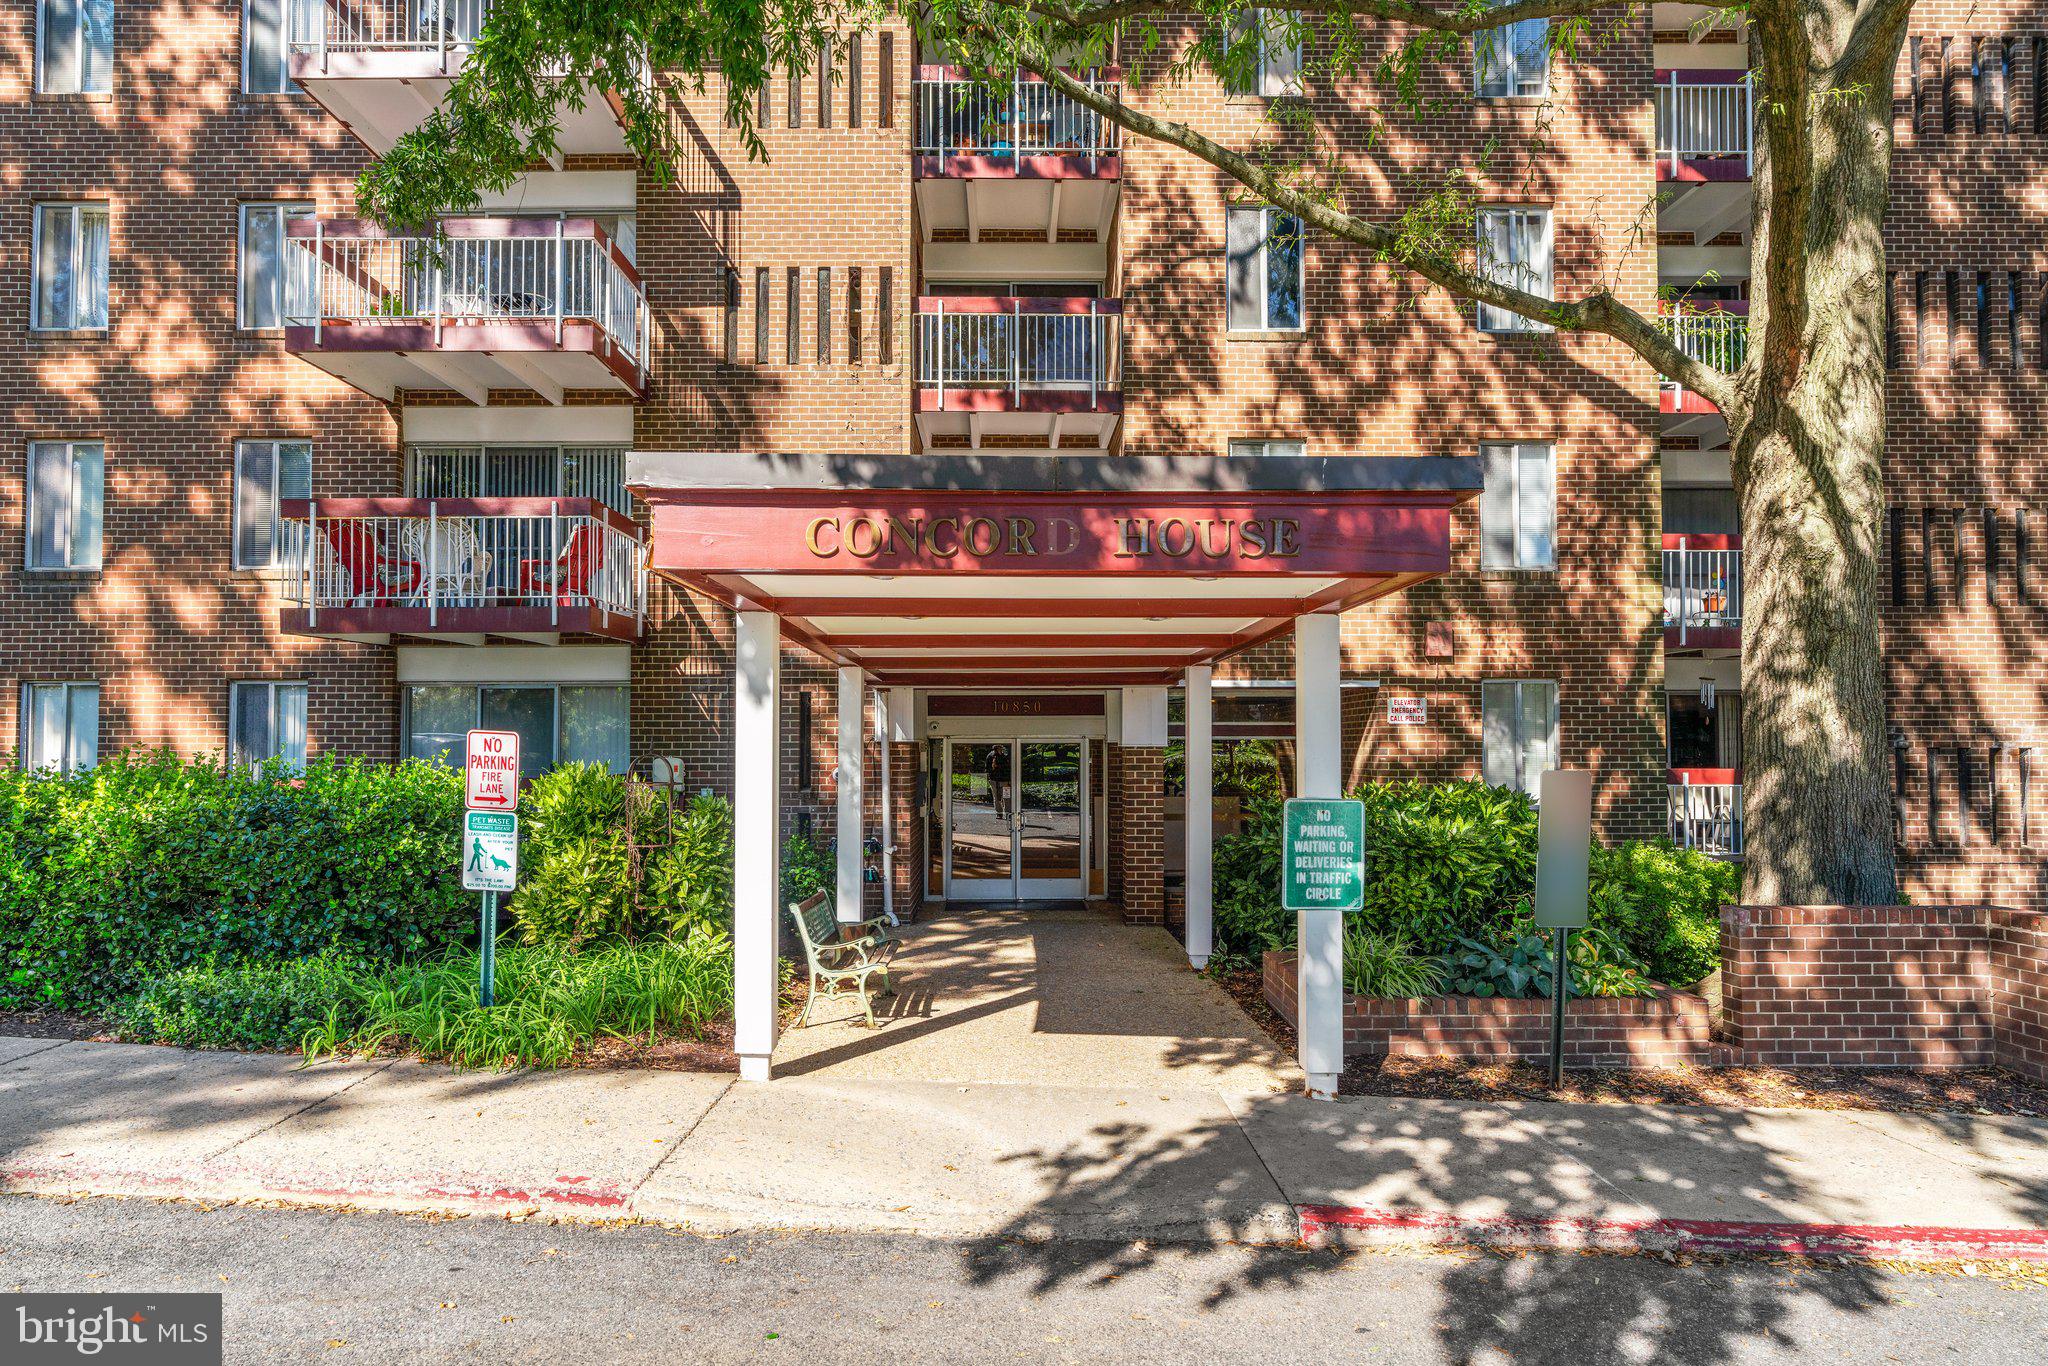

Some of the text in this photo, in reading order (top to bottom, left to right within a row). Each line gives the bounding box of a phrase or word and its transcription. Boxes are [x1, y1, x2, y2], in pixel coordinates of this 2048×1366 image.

[1113, 517, 1301, 559] HOUSE
[993, 700, 1041, 713] 10850
[484, 738, 502, 753] NO
[471, 754, 514, 770] PARKING
[482, 772, 502, 782] FIRE
[480, 783, 504, 794] LANE
[472, 816, 510, 825] PET WASTE
[1316, 810, 1331, 821] NO
[1301, 825, 1347, 840] PARKING,
[1294, 841, 1354, 853] WAITING OR
[1295, 856, 1352, 869] DELIVERIES
[1296, 872, 1352, 884] IN TRAFFIC
[1306, 888, 1341, 900] CIRCLE
